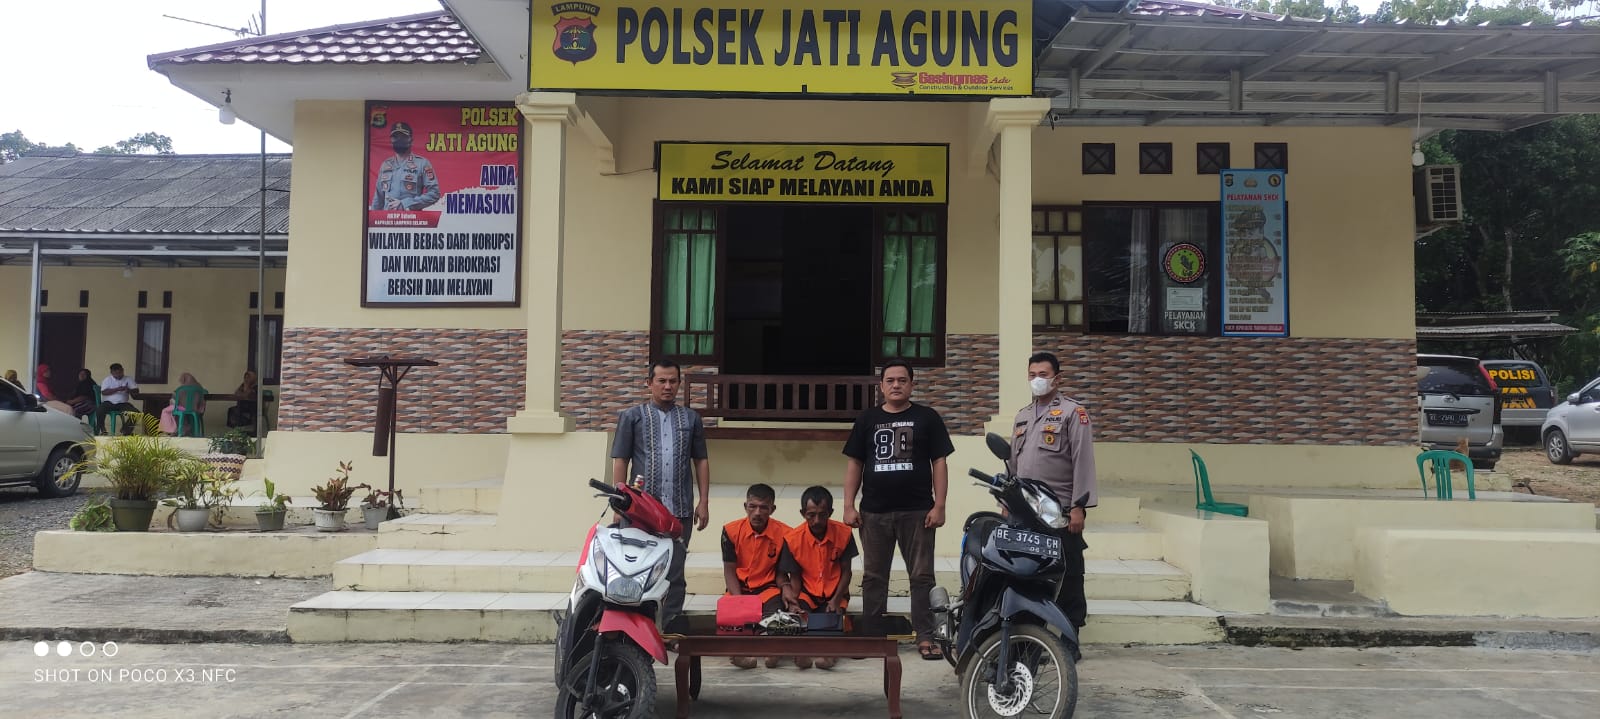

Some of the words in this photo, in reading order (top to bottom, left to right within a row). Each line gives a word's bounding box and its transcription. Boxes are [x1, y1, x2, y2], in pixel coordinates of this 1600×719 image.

[555, 2, 596, 13] LAMPUNG
[616, 7, 765, 65] POLSEK
[774, 9, 861, 66] JATI
[871, 10, 1019, 67] AGUNG
[462, 107, 518, 126] POLSEK
[426, 133, 462, 152] JATI
[465, 133, 518, 152] AGUNG
[711, 149, 805, 172] Selamat
[813, 150, 897, 177] Datang
[480, 165, 516, 186] ANDA
[671, 177, 724, 195] KAMI
[729, 177, 775, 196] SIAP
[779, 178, 875, 197] MELAYANI
[879, 178, 934, 197] ANDA
[446, 193, 515, 214] MEMASUKI
[369, 233, 411, 249] WILAYAH
[413, 233, 444, 250] BEBAS
[447, 233, 469, 250] DARI
[471, 233, 514, 250] KORUPSI
[381, 256, 401, 273] DAN
[403, 256, 445, 273] WILAYAH
[448, 256, 500, 273] BIROKRASI
[387, 279, 423, 296] BERSIH
[425, 279, 445, 295] DAN
[447, 279, 493, 295] MELAYANI
[1164, 311, 1206, 320] PELAYANAN
[1173, 321, 1196, 329] SKCK
[1488, 369, 1535, 380] POLISI
[875, 463, 913, 471] LEGEND
[997, 528, 1009, 540] BE
[1015, 532, 1040, 545] 3745
